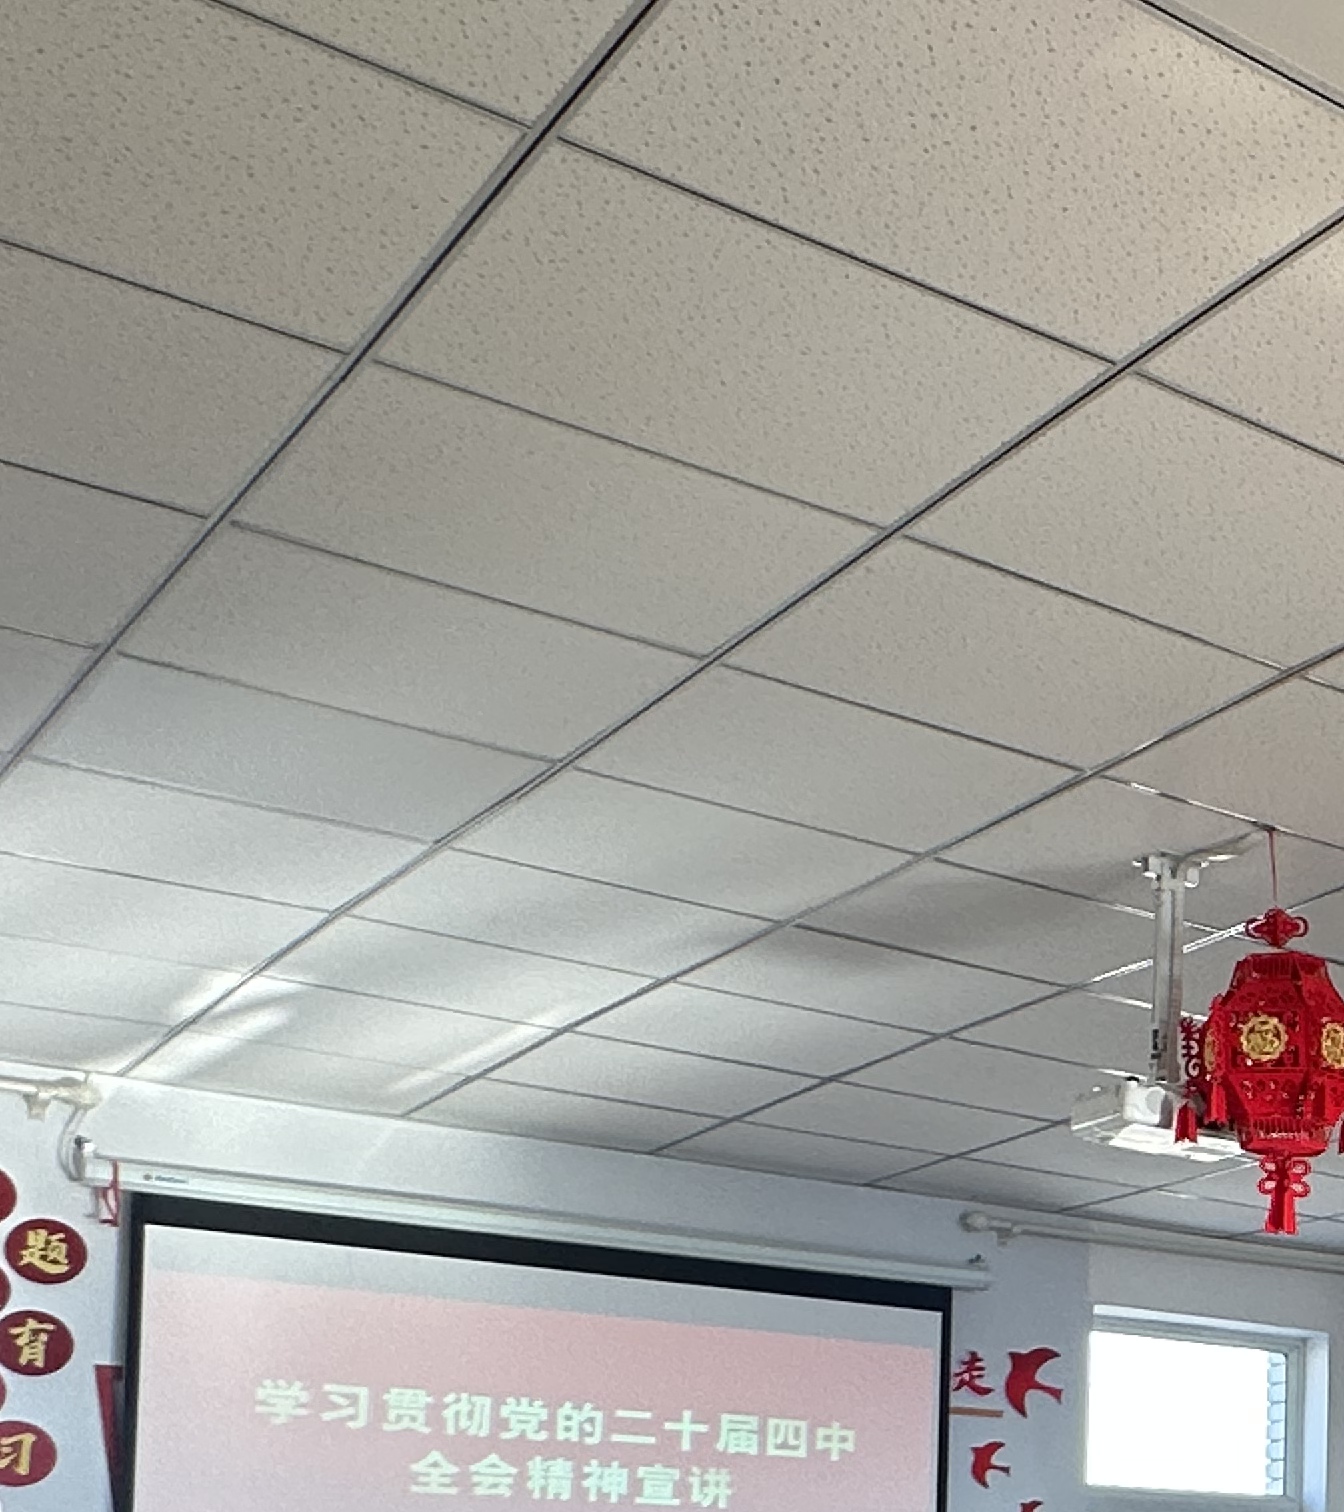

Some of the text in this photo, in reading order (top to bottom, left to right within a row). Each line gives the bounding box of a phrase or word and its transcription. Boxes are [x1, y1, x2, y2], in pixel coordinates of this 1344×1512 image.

[18, 1228, 71, 1274] 题
[8, 1318, 57, 1368] 育
[953, 1350, 995, 1396] 走
[254, 1377, 857, 1462] 学习贯彻党的二十届四中
[409, 1450, 734, 1510] 全会精神宣讲
